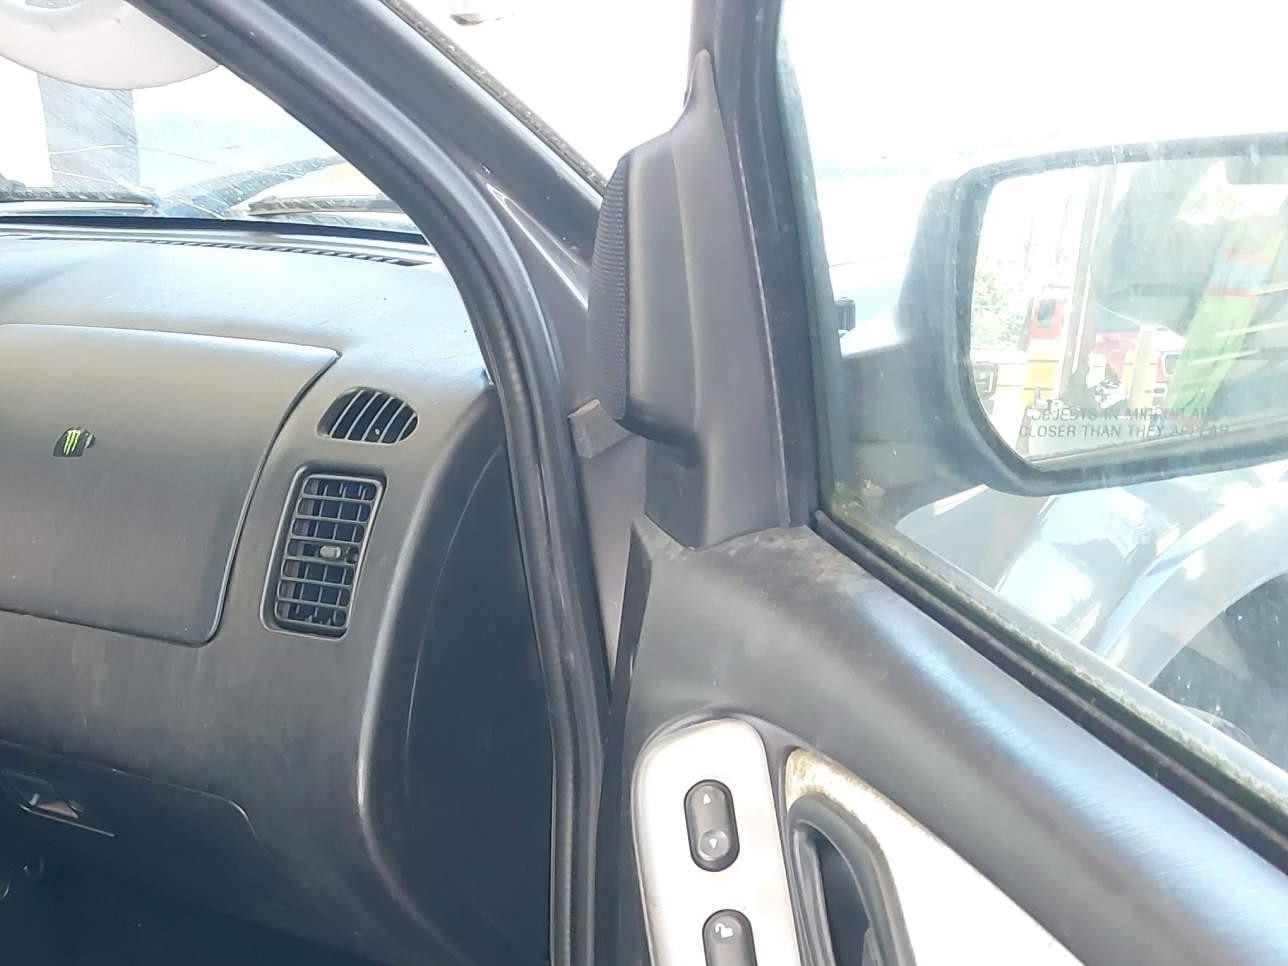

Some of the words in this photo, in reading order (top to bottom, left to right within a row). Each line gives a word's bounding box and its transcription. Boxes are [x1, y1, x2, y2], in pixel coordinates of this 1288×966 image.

[1019, 425, 1077, 438] CLOSER
[1081, 425, 1122, 438] THAN
[1127, 425, 1164, 438] THEY
